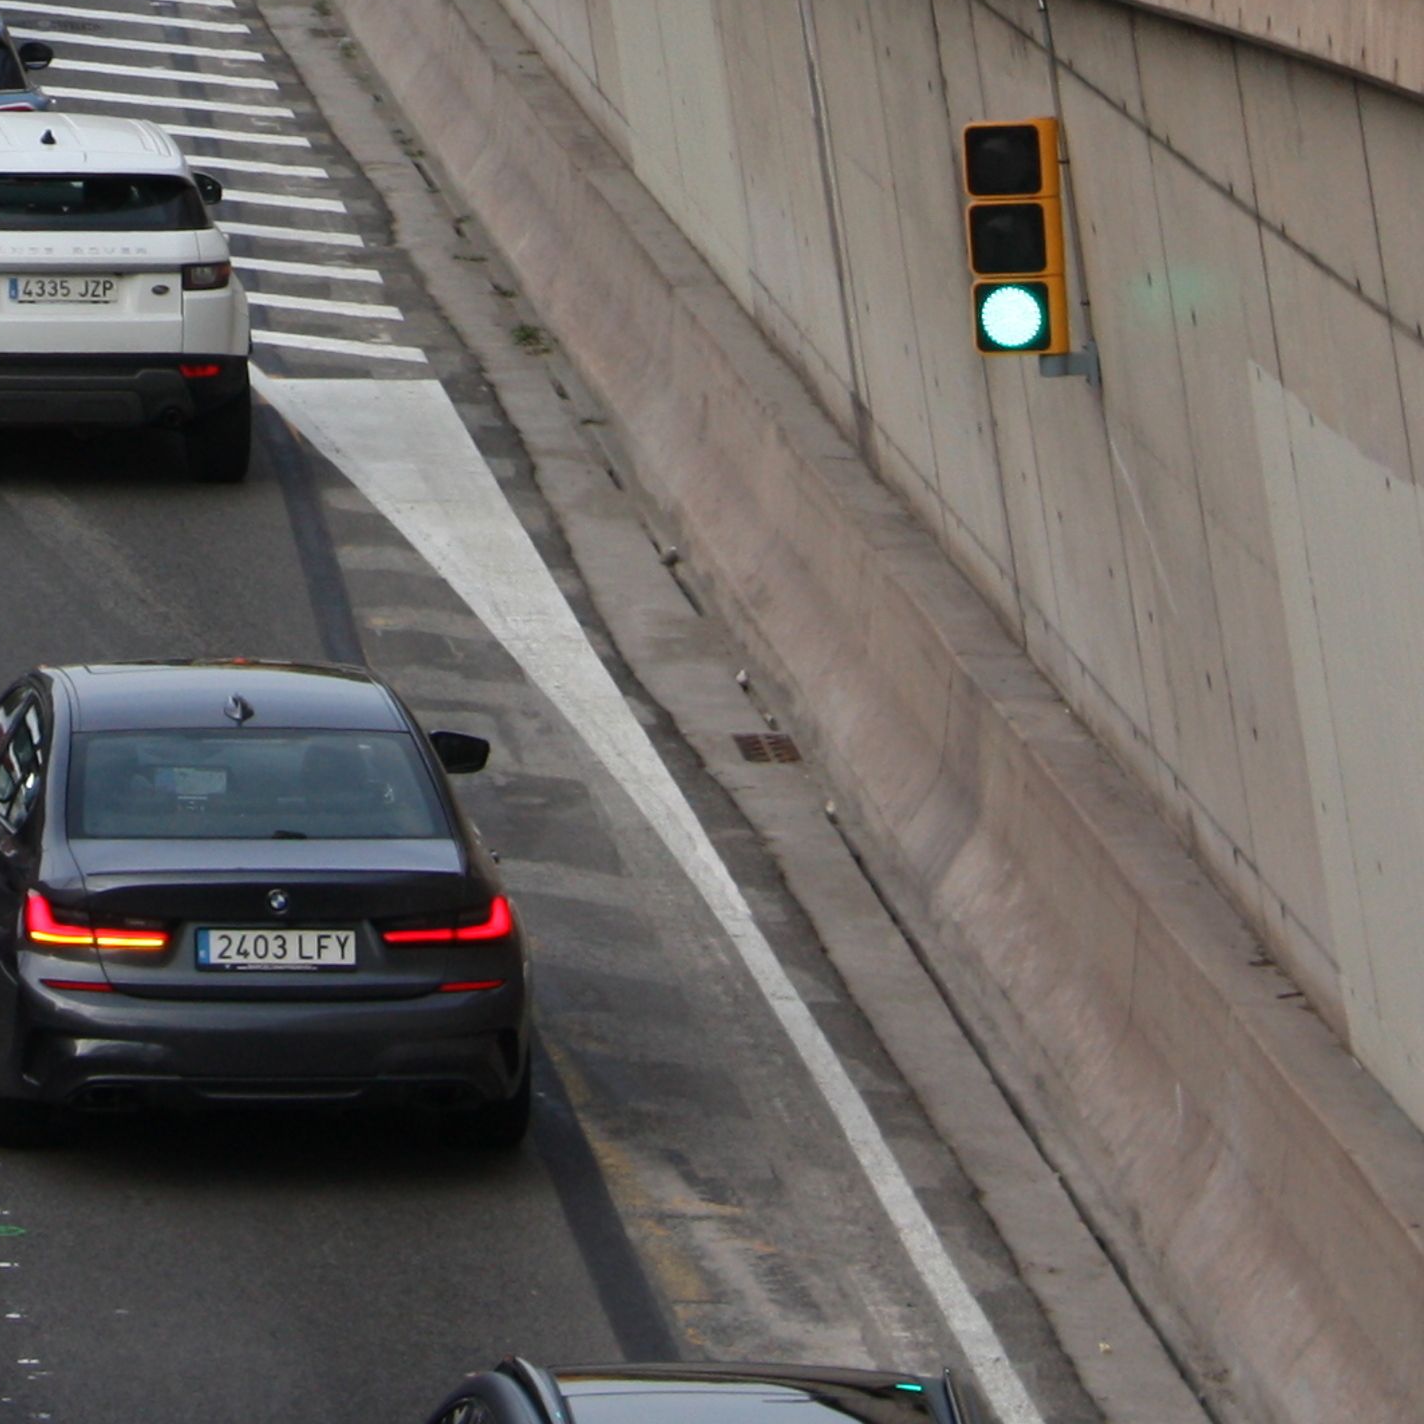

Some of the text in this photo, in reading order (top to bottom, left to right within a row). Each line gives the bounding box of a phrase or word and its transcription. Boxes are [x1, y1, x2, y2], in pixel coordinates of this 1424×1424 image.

[22, 280, 114, 298] 4335 JZP
[217, 934, 351, 960] 2403 LFY
